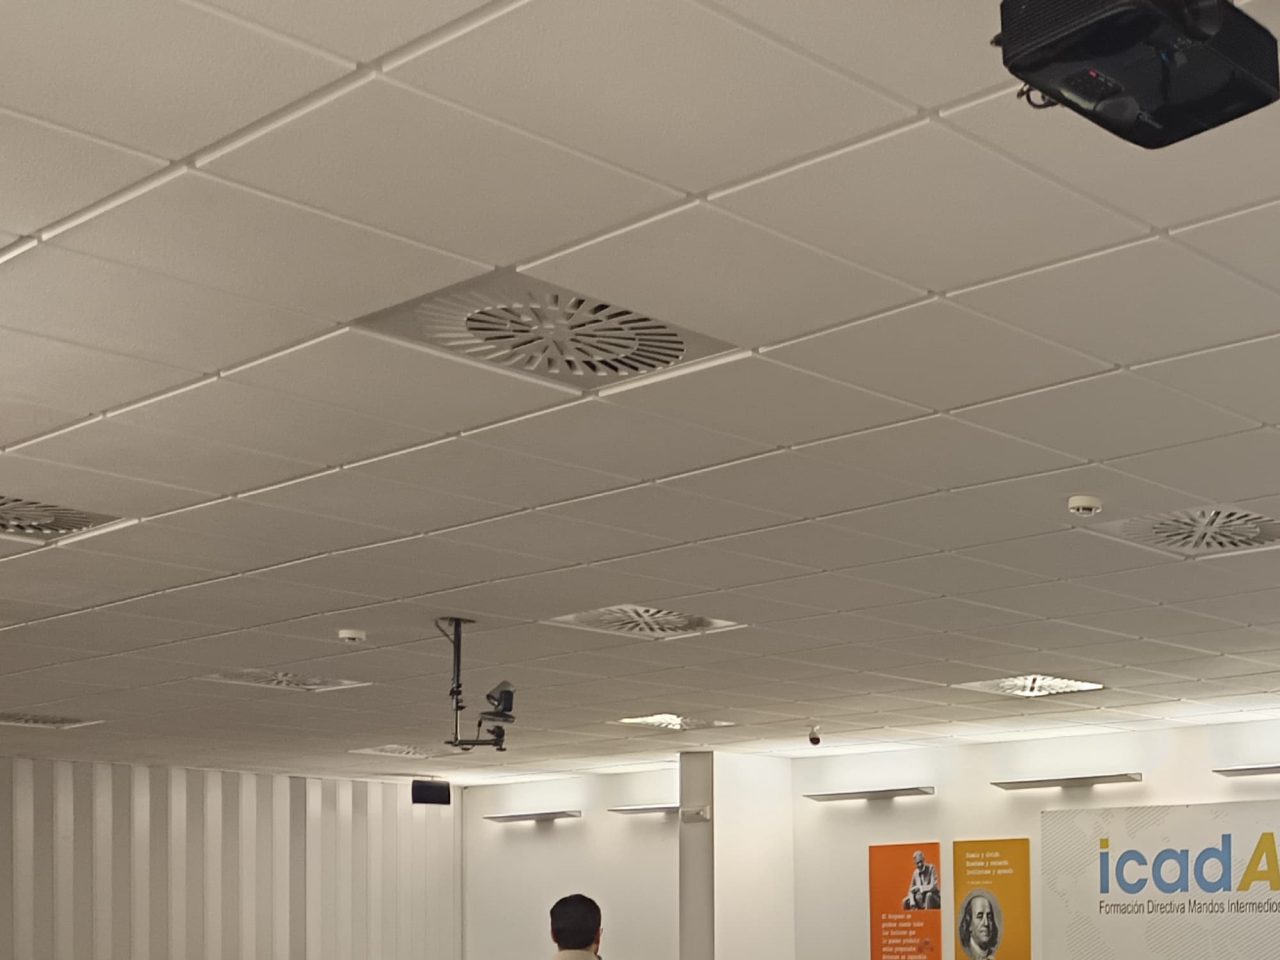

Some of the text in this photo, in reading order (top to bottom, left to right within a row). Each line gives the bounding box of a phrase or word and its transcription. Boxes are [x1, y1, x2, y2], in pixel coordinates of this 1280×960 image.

[1099, 899, 1145, 915] Formación
[1147, 899, 1186, 914] Directiva
[1188, 899, 1225, 914] Mandos
